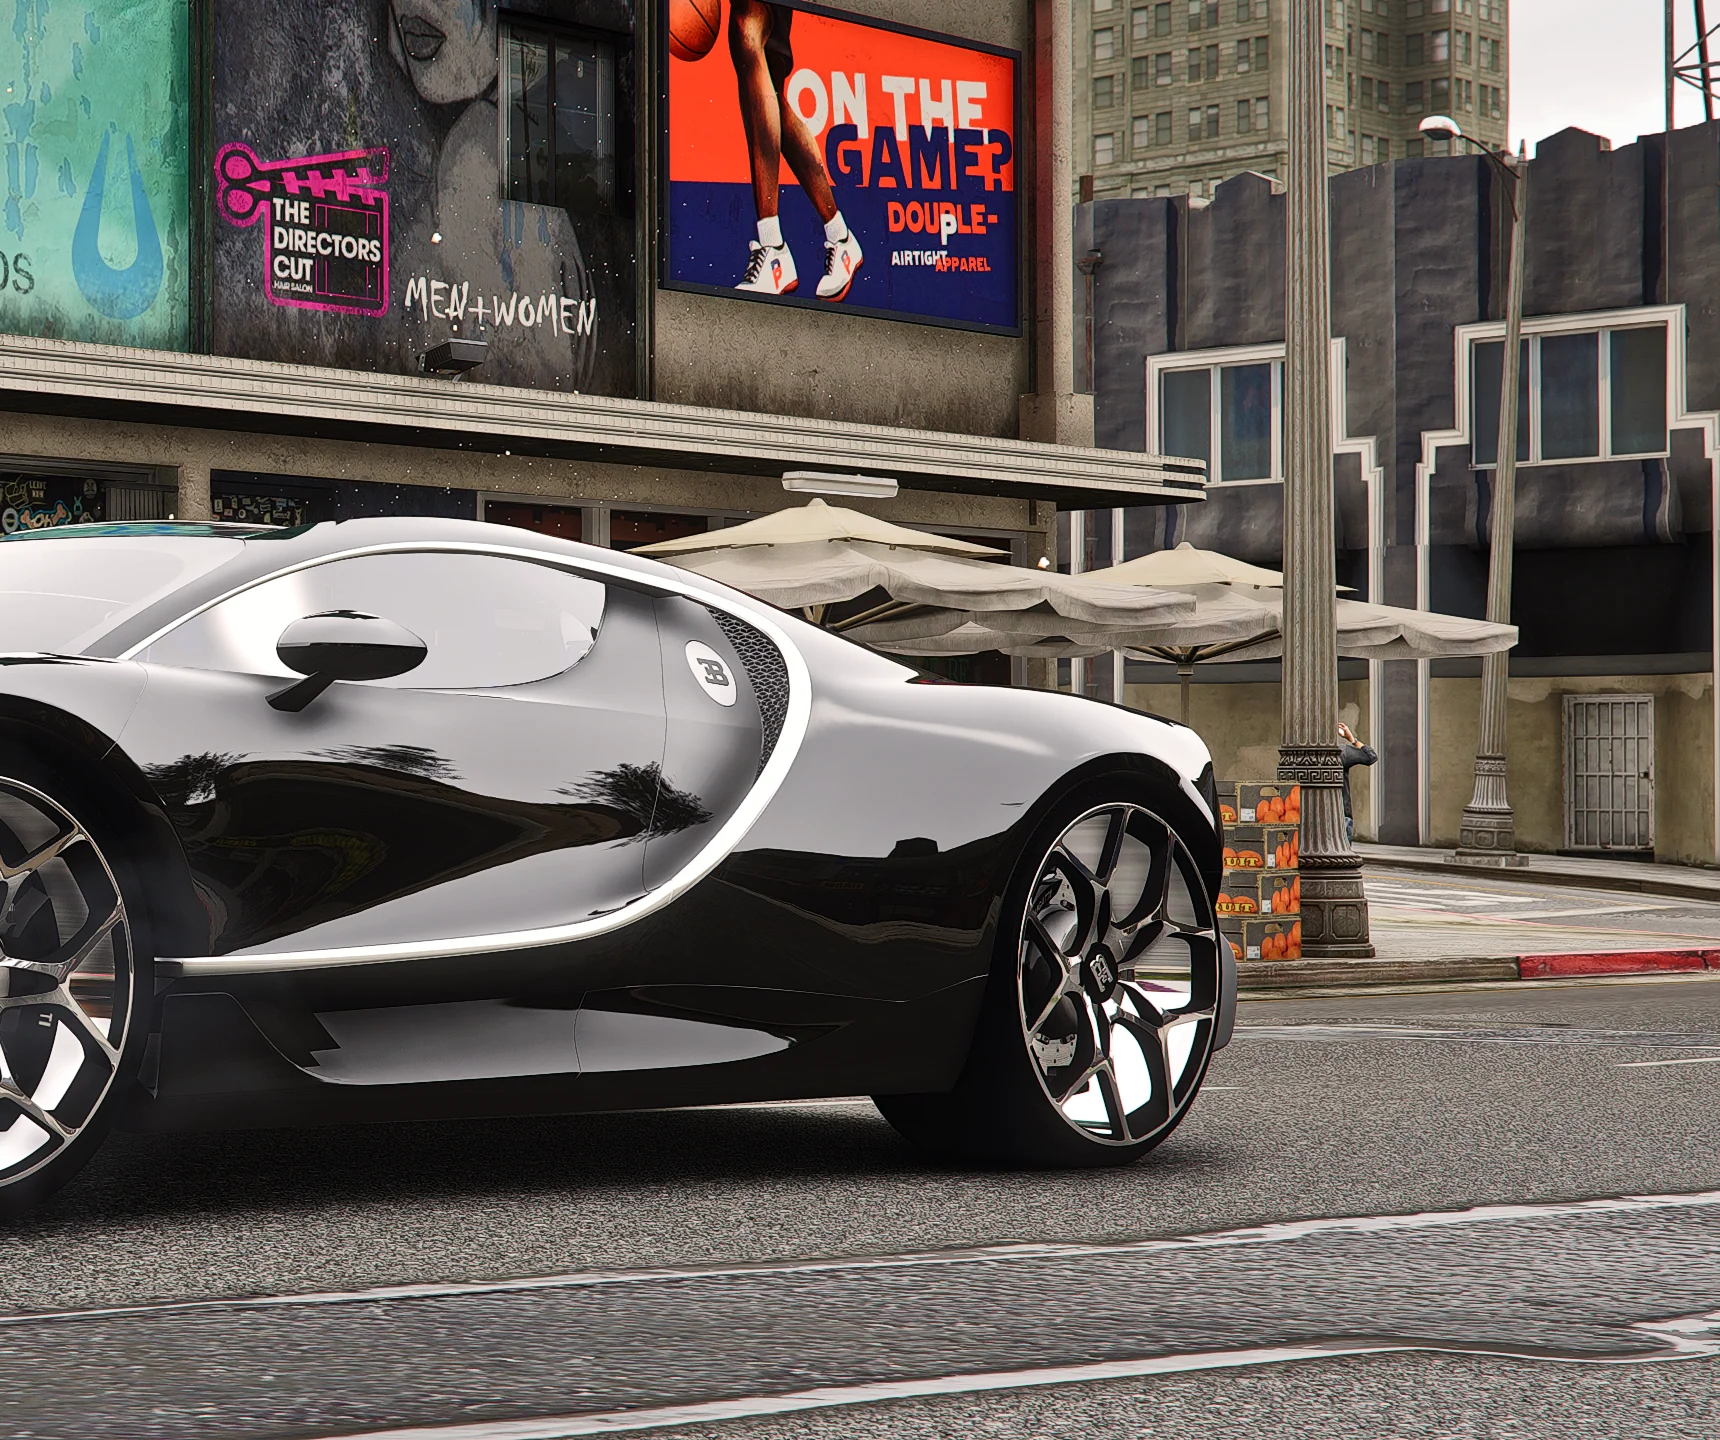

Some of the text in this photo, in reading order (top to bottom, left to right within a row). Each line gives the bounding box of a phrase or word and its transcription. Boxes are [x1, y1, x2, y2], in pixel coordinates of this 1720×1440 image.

[787, 68, 988, 144] ON THE
[826, 124, 1012, 191] GAME?
[272, 197, 310, 225] THE
[273, 225, 381, 262] DIRECTORS
[273, 254, 314, 281] CUT
[892, 250, 948, 266] AIRTIGHT
[935, 257, 991, 272] APPAREL
[272, 280, 313, 293] HAIR SALON
